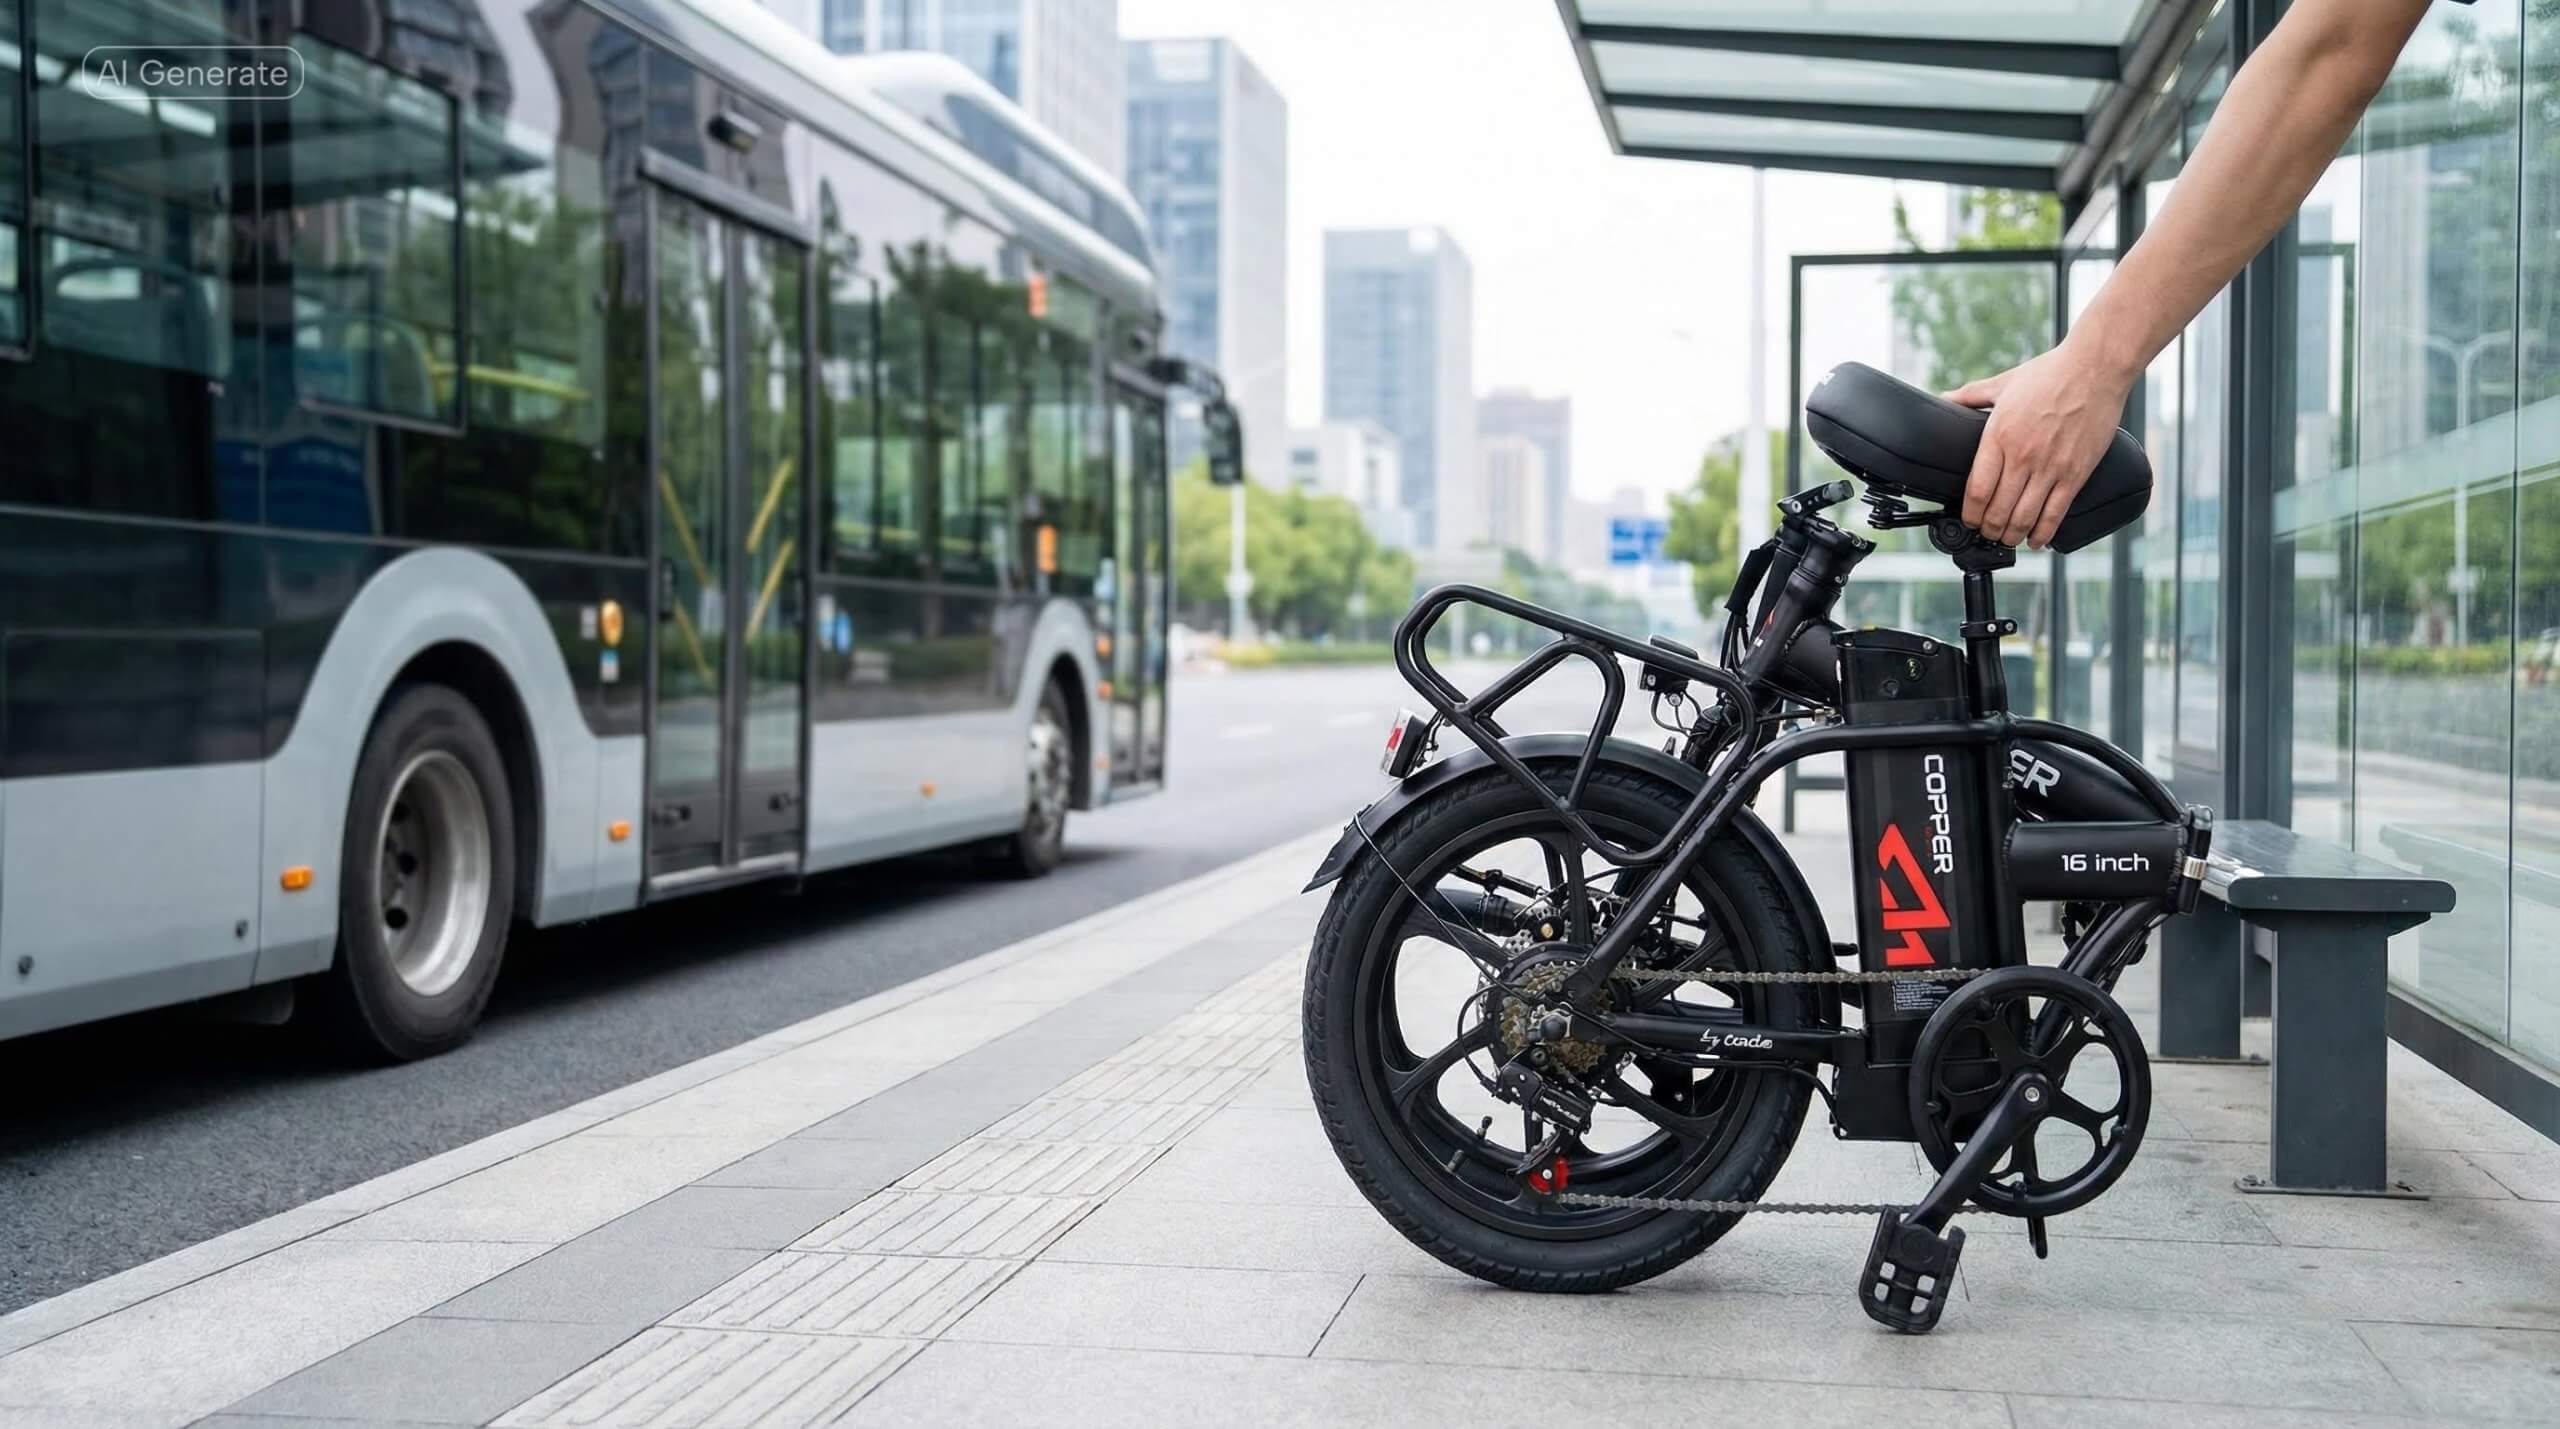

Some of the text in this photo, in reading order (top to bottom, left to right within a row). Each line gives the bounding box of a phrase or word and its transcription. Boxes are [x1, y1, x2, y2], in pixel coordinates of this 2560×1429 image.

[1924, 754, 1954, 874] COPPER
[2061, 852, 2150, 872] 16 inch
